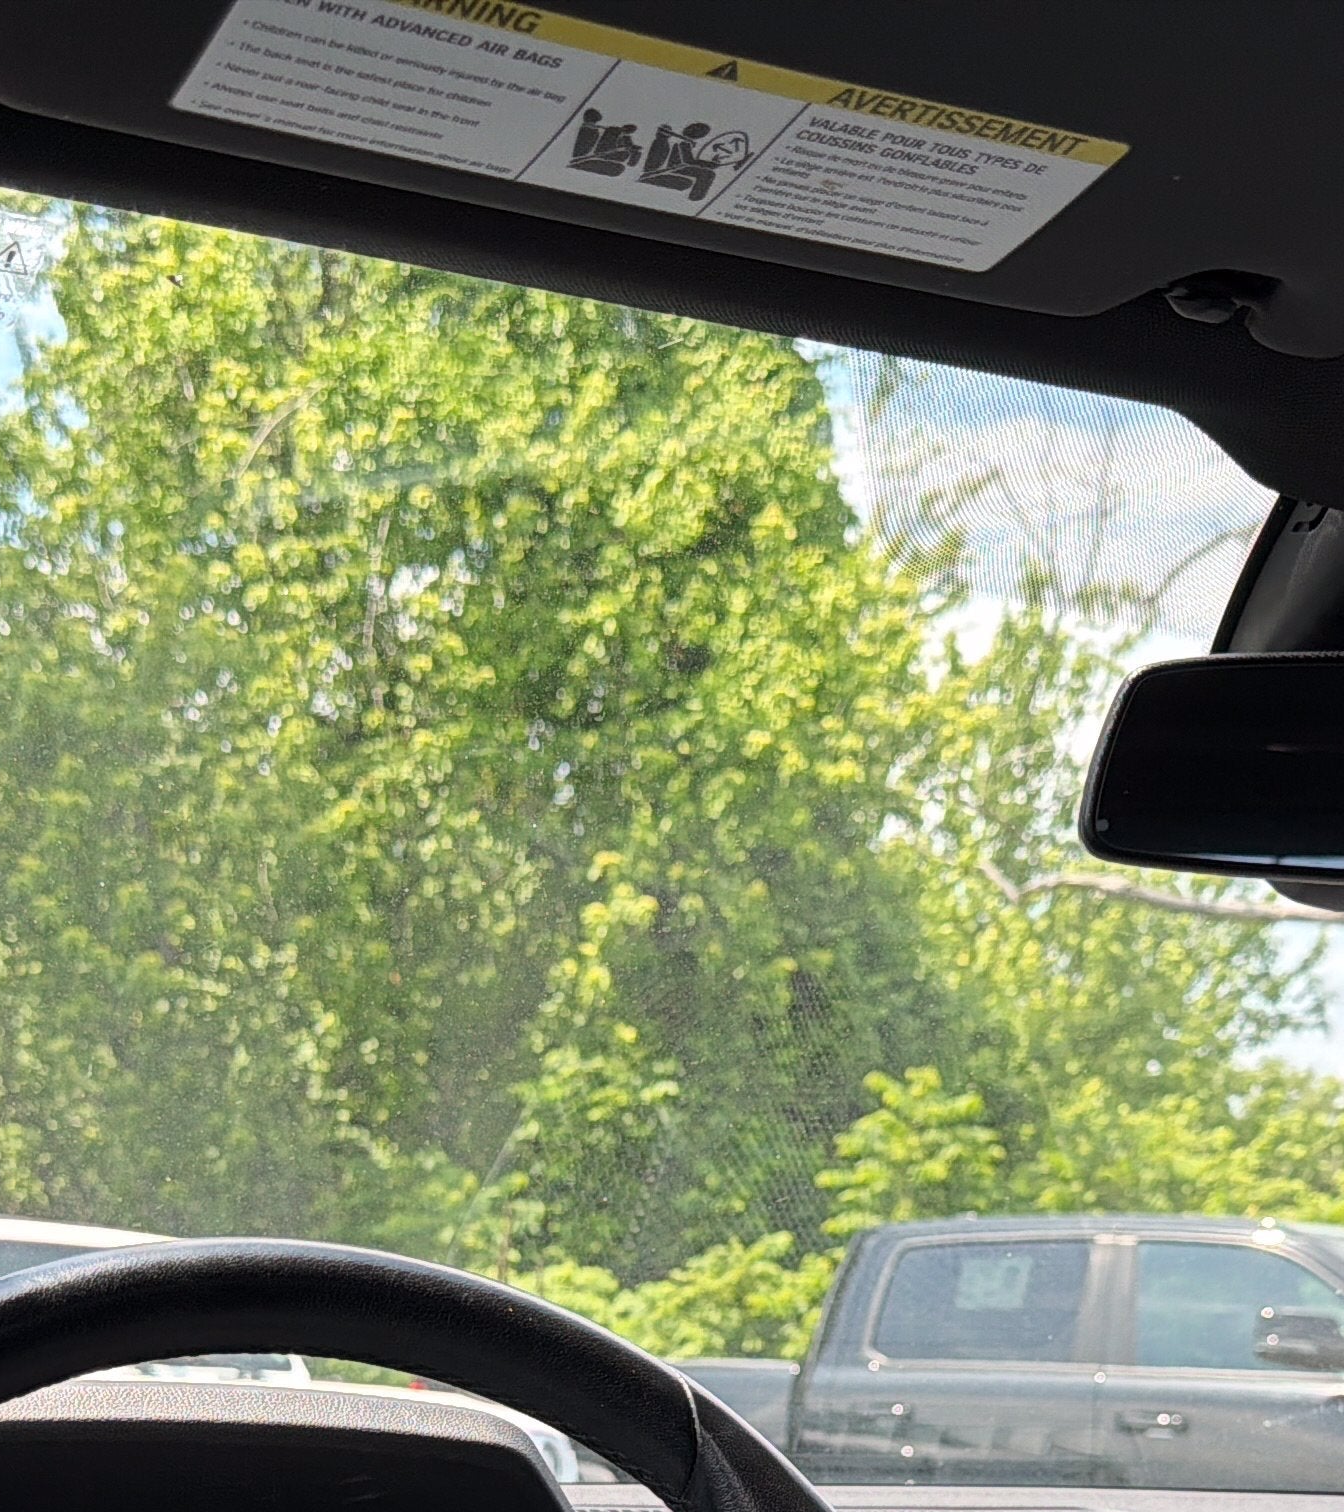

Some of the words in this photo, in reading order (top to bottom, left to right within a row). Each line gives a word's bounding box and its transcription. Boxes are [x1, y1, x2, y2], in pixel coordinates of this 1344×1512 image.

[318, 2, 367, 20] WITH
[371, 15, 472, 46] ADVANCED
[476, 41, 509, 56] AIR
[513, 49, 564, 69] BAGS
[796, 129, 878, 154] COUSSINS
[879, 147, 979, 175] GONFLABLES
[809, 116, 880, 141] VALABLE
[881, 132, 927, 150] POUR
[929, 143, 972, 159] TOUS
[973, 152, 1024, 170] TYPES
[1023, 162, 1048, 175] DE
[826, 88, 1088, 155] AVERTISSEMENT
